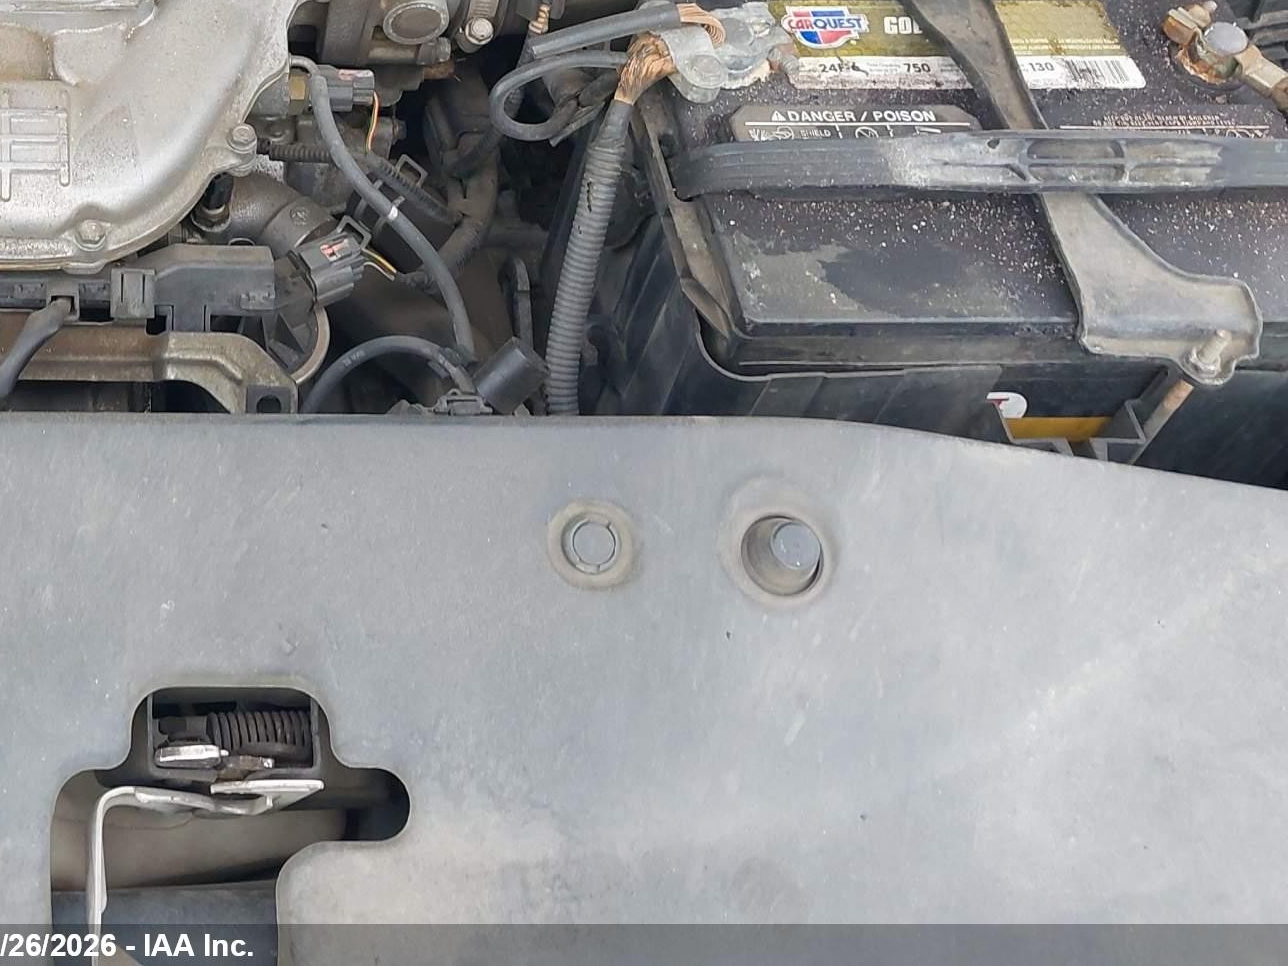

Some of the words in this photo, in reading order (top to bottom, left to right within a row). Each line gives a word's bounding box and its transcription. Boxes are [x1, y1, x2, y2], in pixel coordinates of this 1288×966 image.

[788, 17, 863, 30] CARQUEST
[884, 16, 923, 34] GOL
[903, 63, 931, 73] 750
[1029, 62, 1055, 72] 130
[787, 111, 856, 122] DANGER
[861, 111, 868, 122] /
[874, 110, 936, 122] POISON
